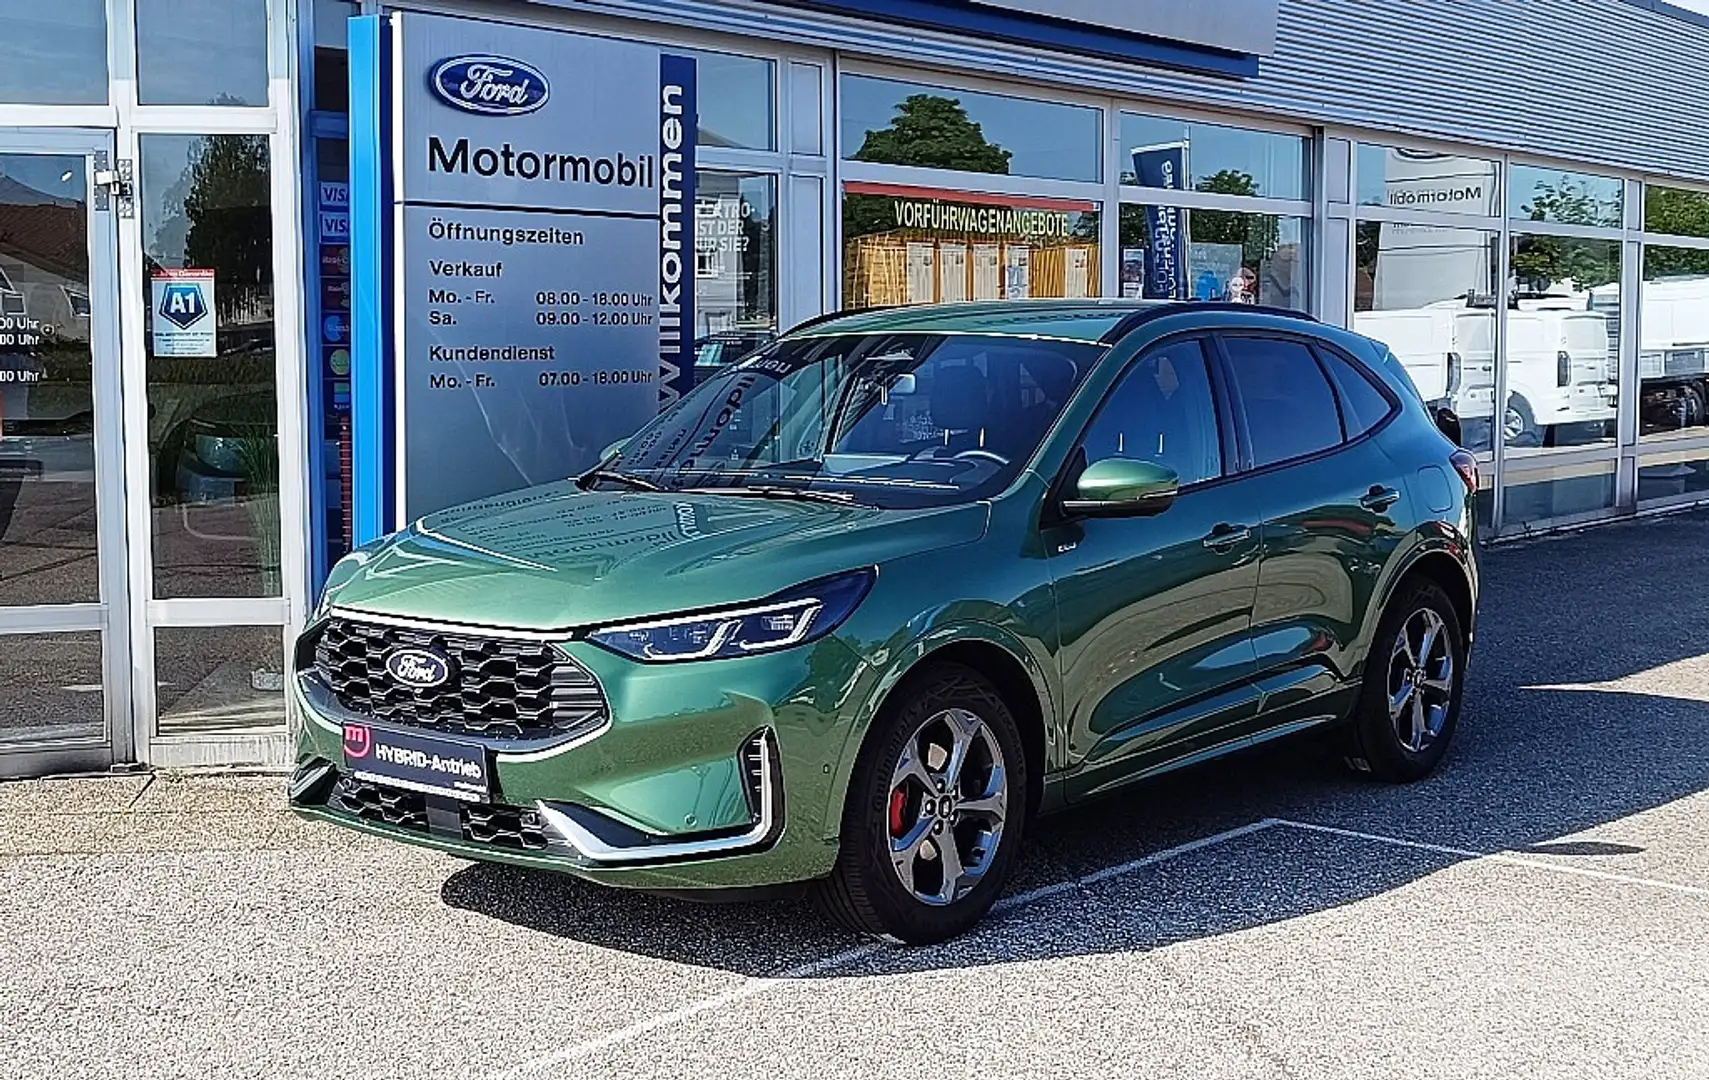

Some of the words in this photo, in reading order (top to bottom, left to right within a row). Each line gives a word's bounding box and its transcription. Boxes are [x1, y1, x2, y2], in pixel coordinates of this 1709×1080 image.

[459, 63, 529, 105] Ford
[427, 136, 654, 188] Motormobil
[322, 187, 348, 202] VIS
[324, 218, 349, 233] VIS
[894, 198, 1069, 237] VORFÜHRWAGENANGEBOTE
[428, 216, 584, 246] Öffnungszeiten
[717, 219, 744, 235] DER
[719, 236, 750, 252] SIE?
[428, 260, 503, 278] Verkauf
[169, 291, 196, 314] A1
[428, 288, 462, 304] Mo.
[475, 290, 496, 304] Fr.
[535, 291, 580, 305] 08.00
[592, 292, 629, 307] 18.00
[631, 292, 654, 307] Uhr
[17, 317, 40, 330] Uhr
[428, 310, 457, 325] Sa.
[535, 311, 580, 325] 09.00
[592, 311, 629, 325] 12.00
[631, 311, 654, 325] Uhr
[18, 334, 40, 345] Uhr
[429, 344, 556, 362] Kundendienst
[17, 370, 40, 382] Uhr
[429, 373, 462, 389] Mo.
[475, 373, 496, 388] Fr.
[538, 371, 580, 386] 07.00
[592, 370, 629, 385] 18.00
[631, 370, 653, 384] Uhr
[397, 654, 437, 682] Ford
[375, 742, 482, 779] HYBRID-Antrieb
